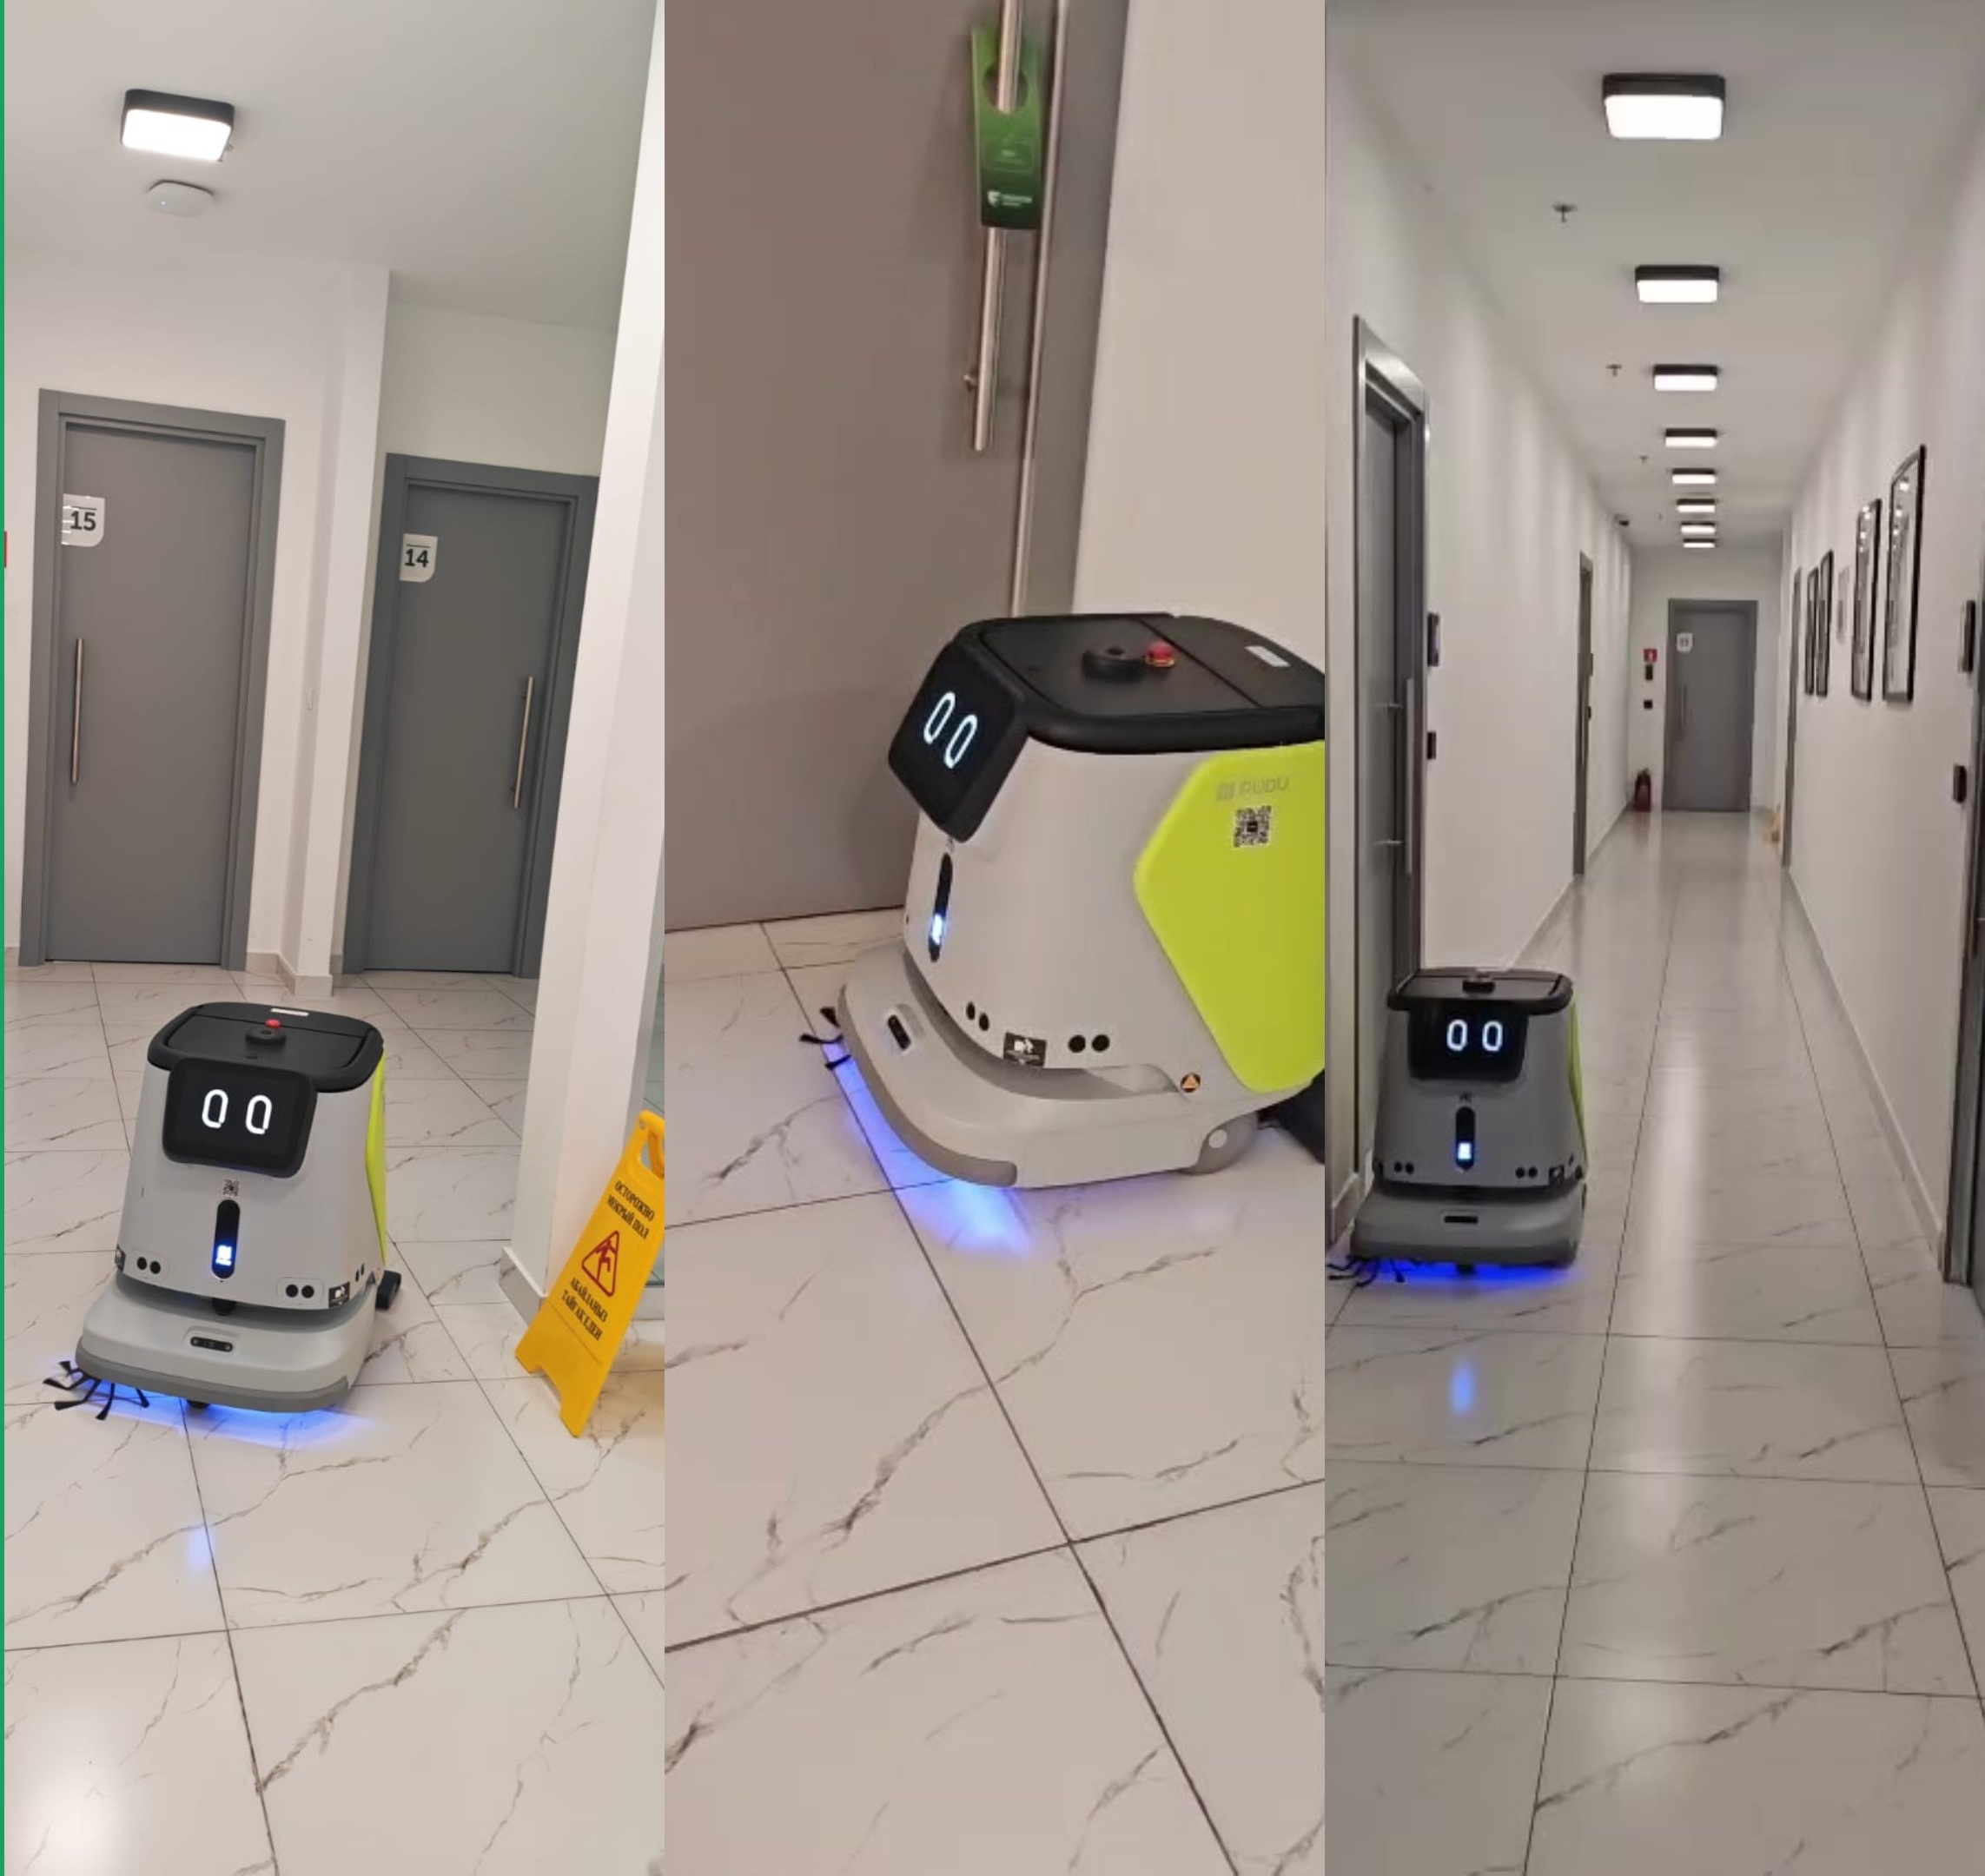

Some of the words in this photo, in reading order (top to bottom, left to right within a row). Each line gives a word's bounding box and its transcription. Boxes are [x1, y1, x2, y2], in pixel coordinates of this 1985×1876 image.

[70, 511, 96, 531] 15
[405, 548, 429, 567] 14
[615, 1181, 655, 1222] ОСТОРОЖНО
